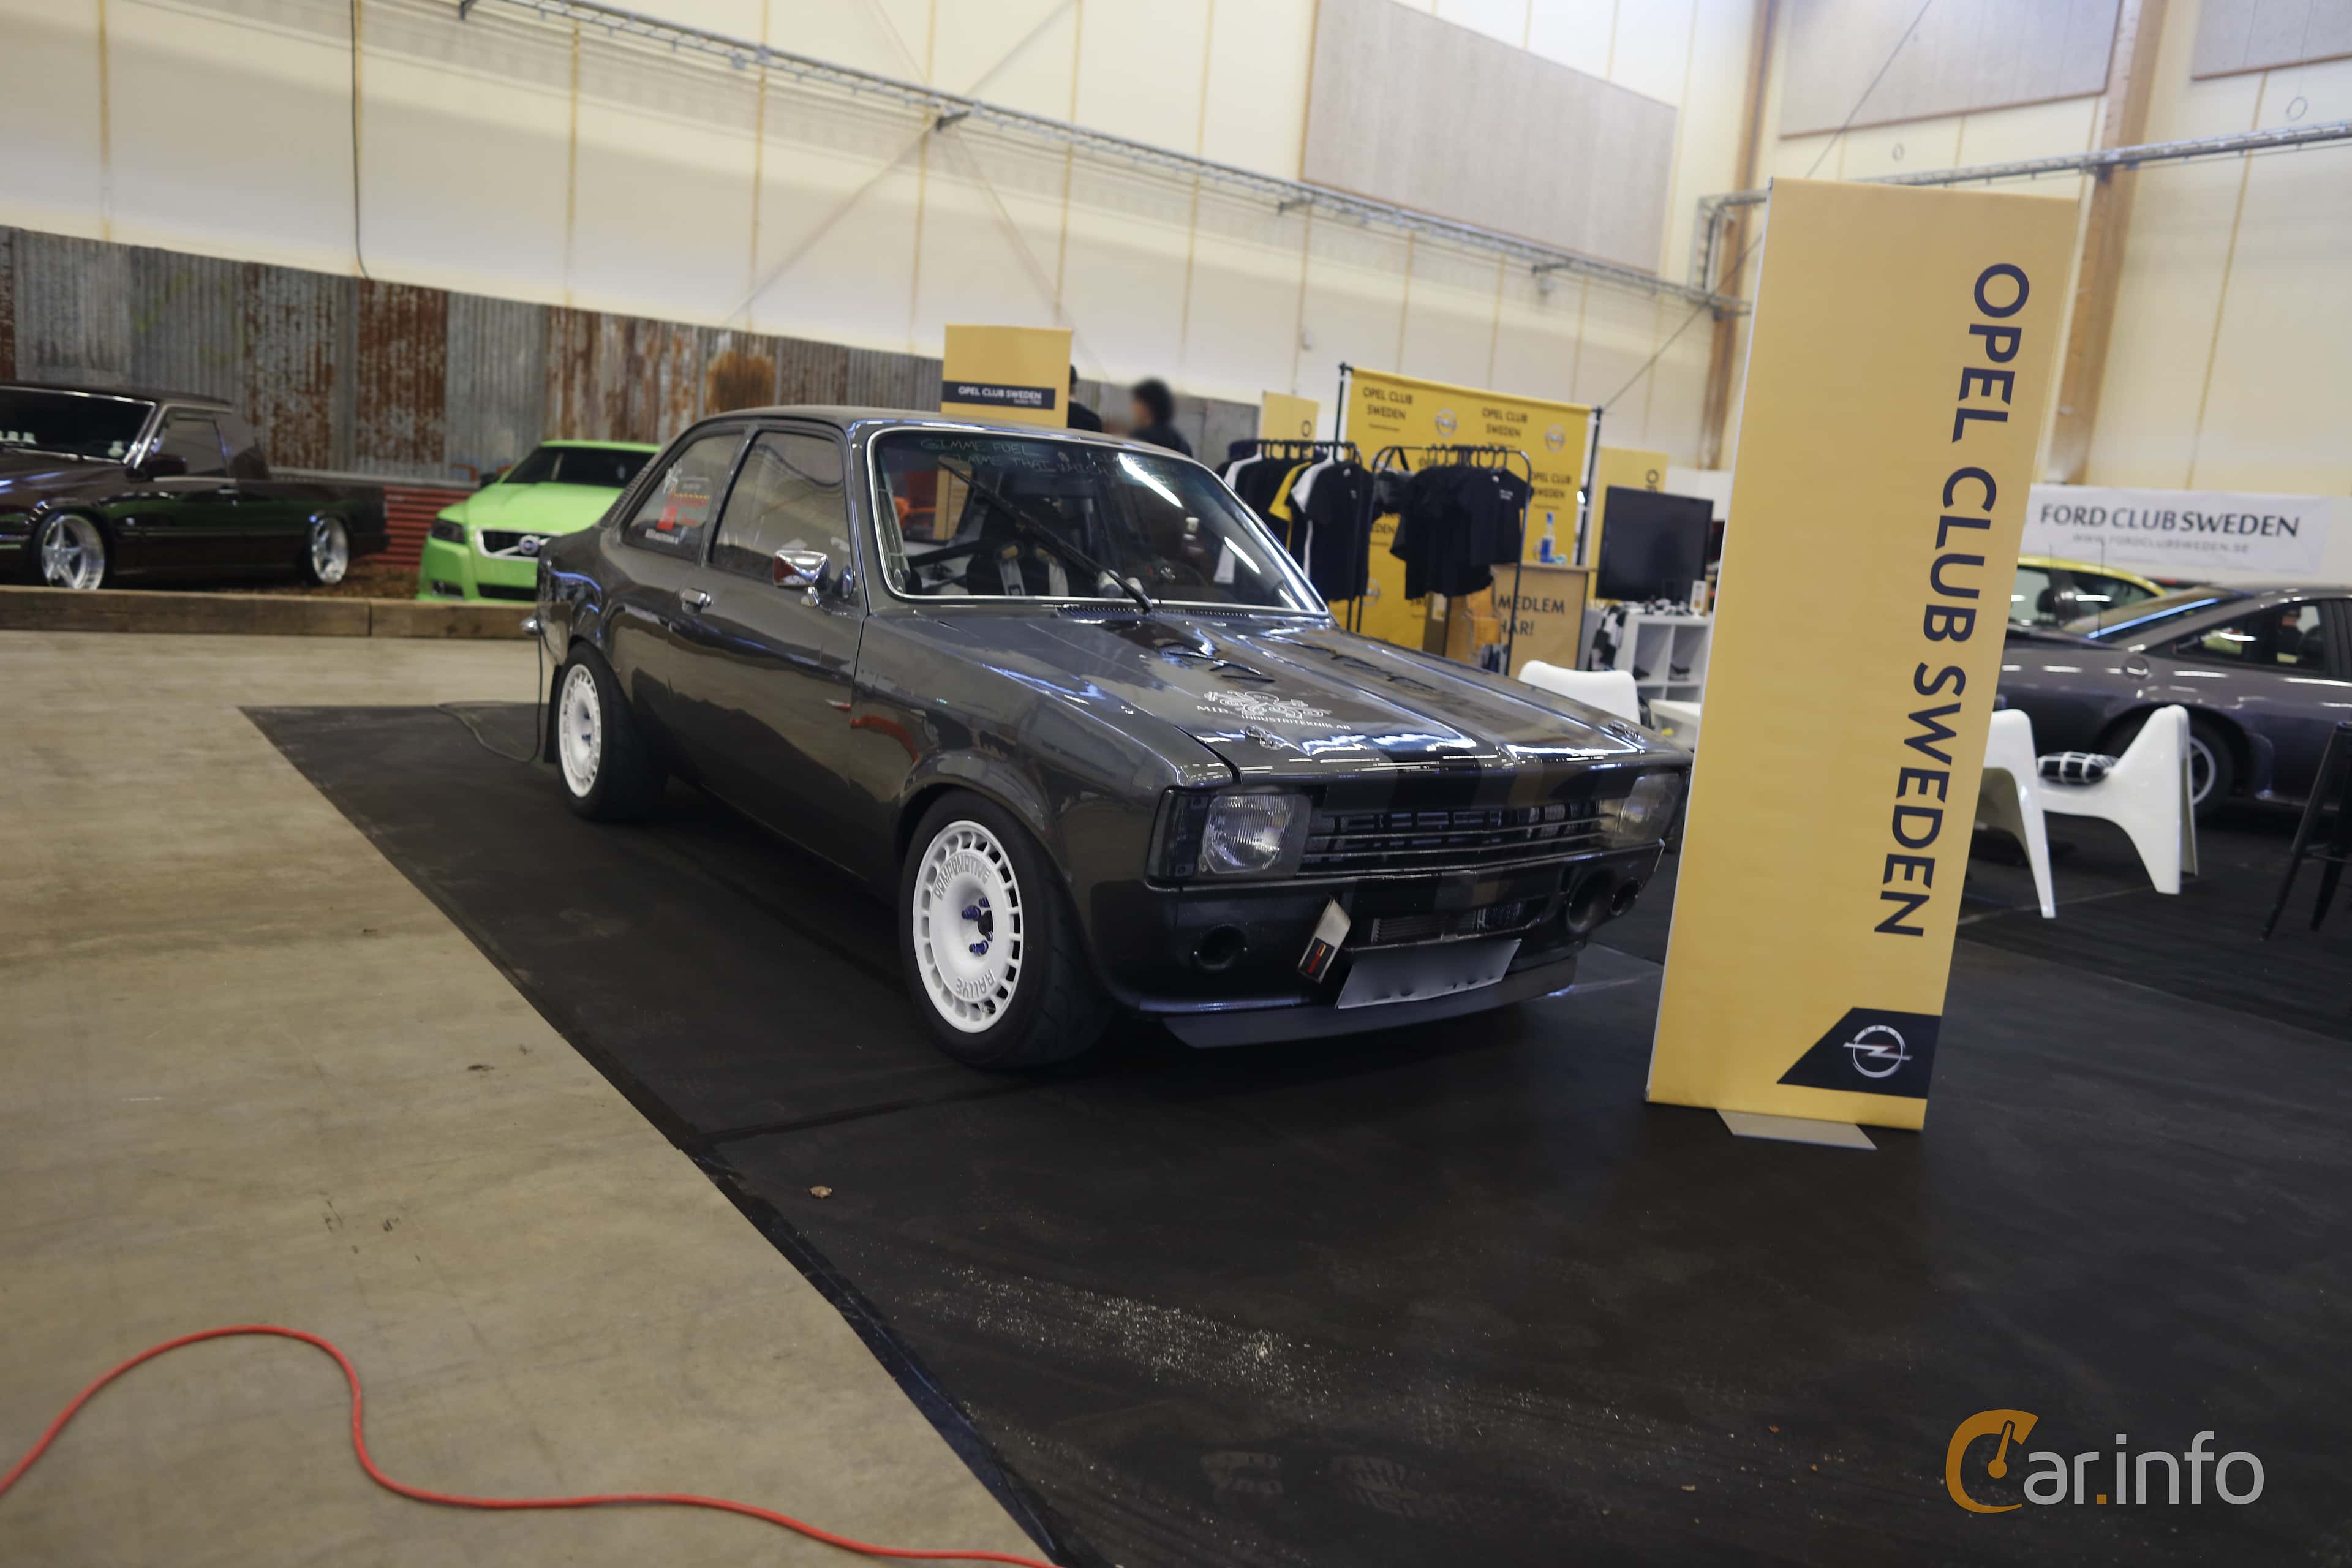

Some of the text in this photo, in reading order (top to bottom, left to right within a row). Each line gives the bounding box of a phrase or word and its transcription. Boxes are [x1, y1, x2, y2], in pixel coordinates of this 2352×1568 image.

[958, 386, 1041, 399] OPEL CLUB SWEDEN
[1363, 386, 1413, 405] OPEL CLUB
[1367, 404, 1406, 420] SWEDEN
[1482, 407, 1528, 424] OPEL CLUB
[1486, 423, 1521, 437] SWEDEN
[992, 441, 1039, 456] FUEL
[1551, 473, 1572, 485] CLUB
[2040, 504, 2301, 538] FORD CLUB SWEDEN
[1874, 263, 2029, 937] OPEL CLUB SWEDEN
[956, 968, 995, 999] RALLYE
